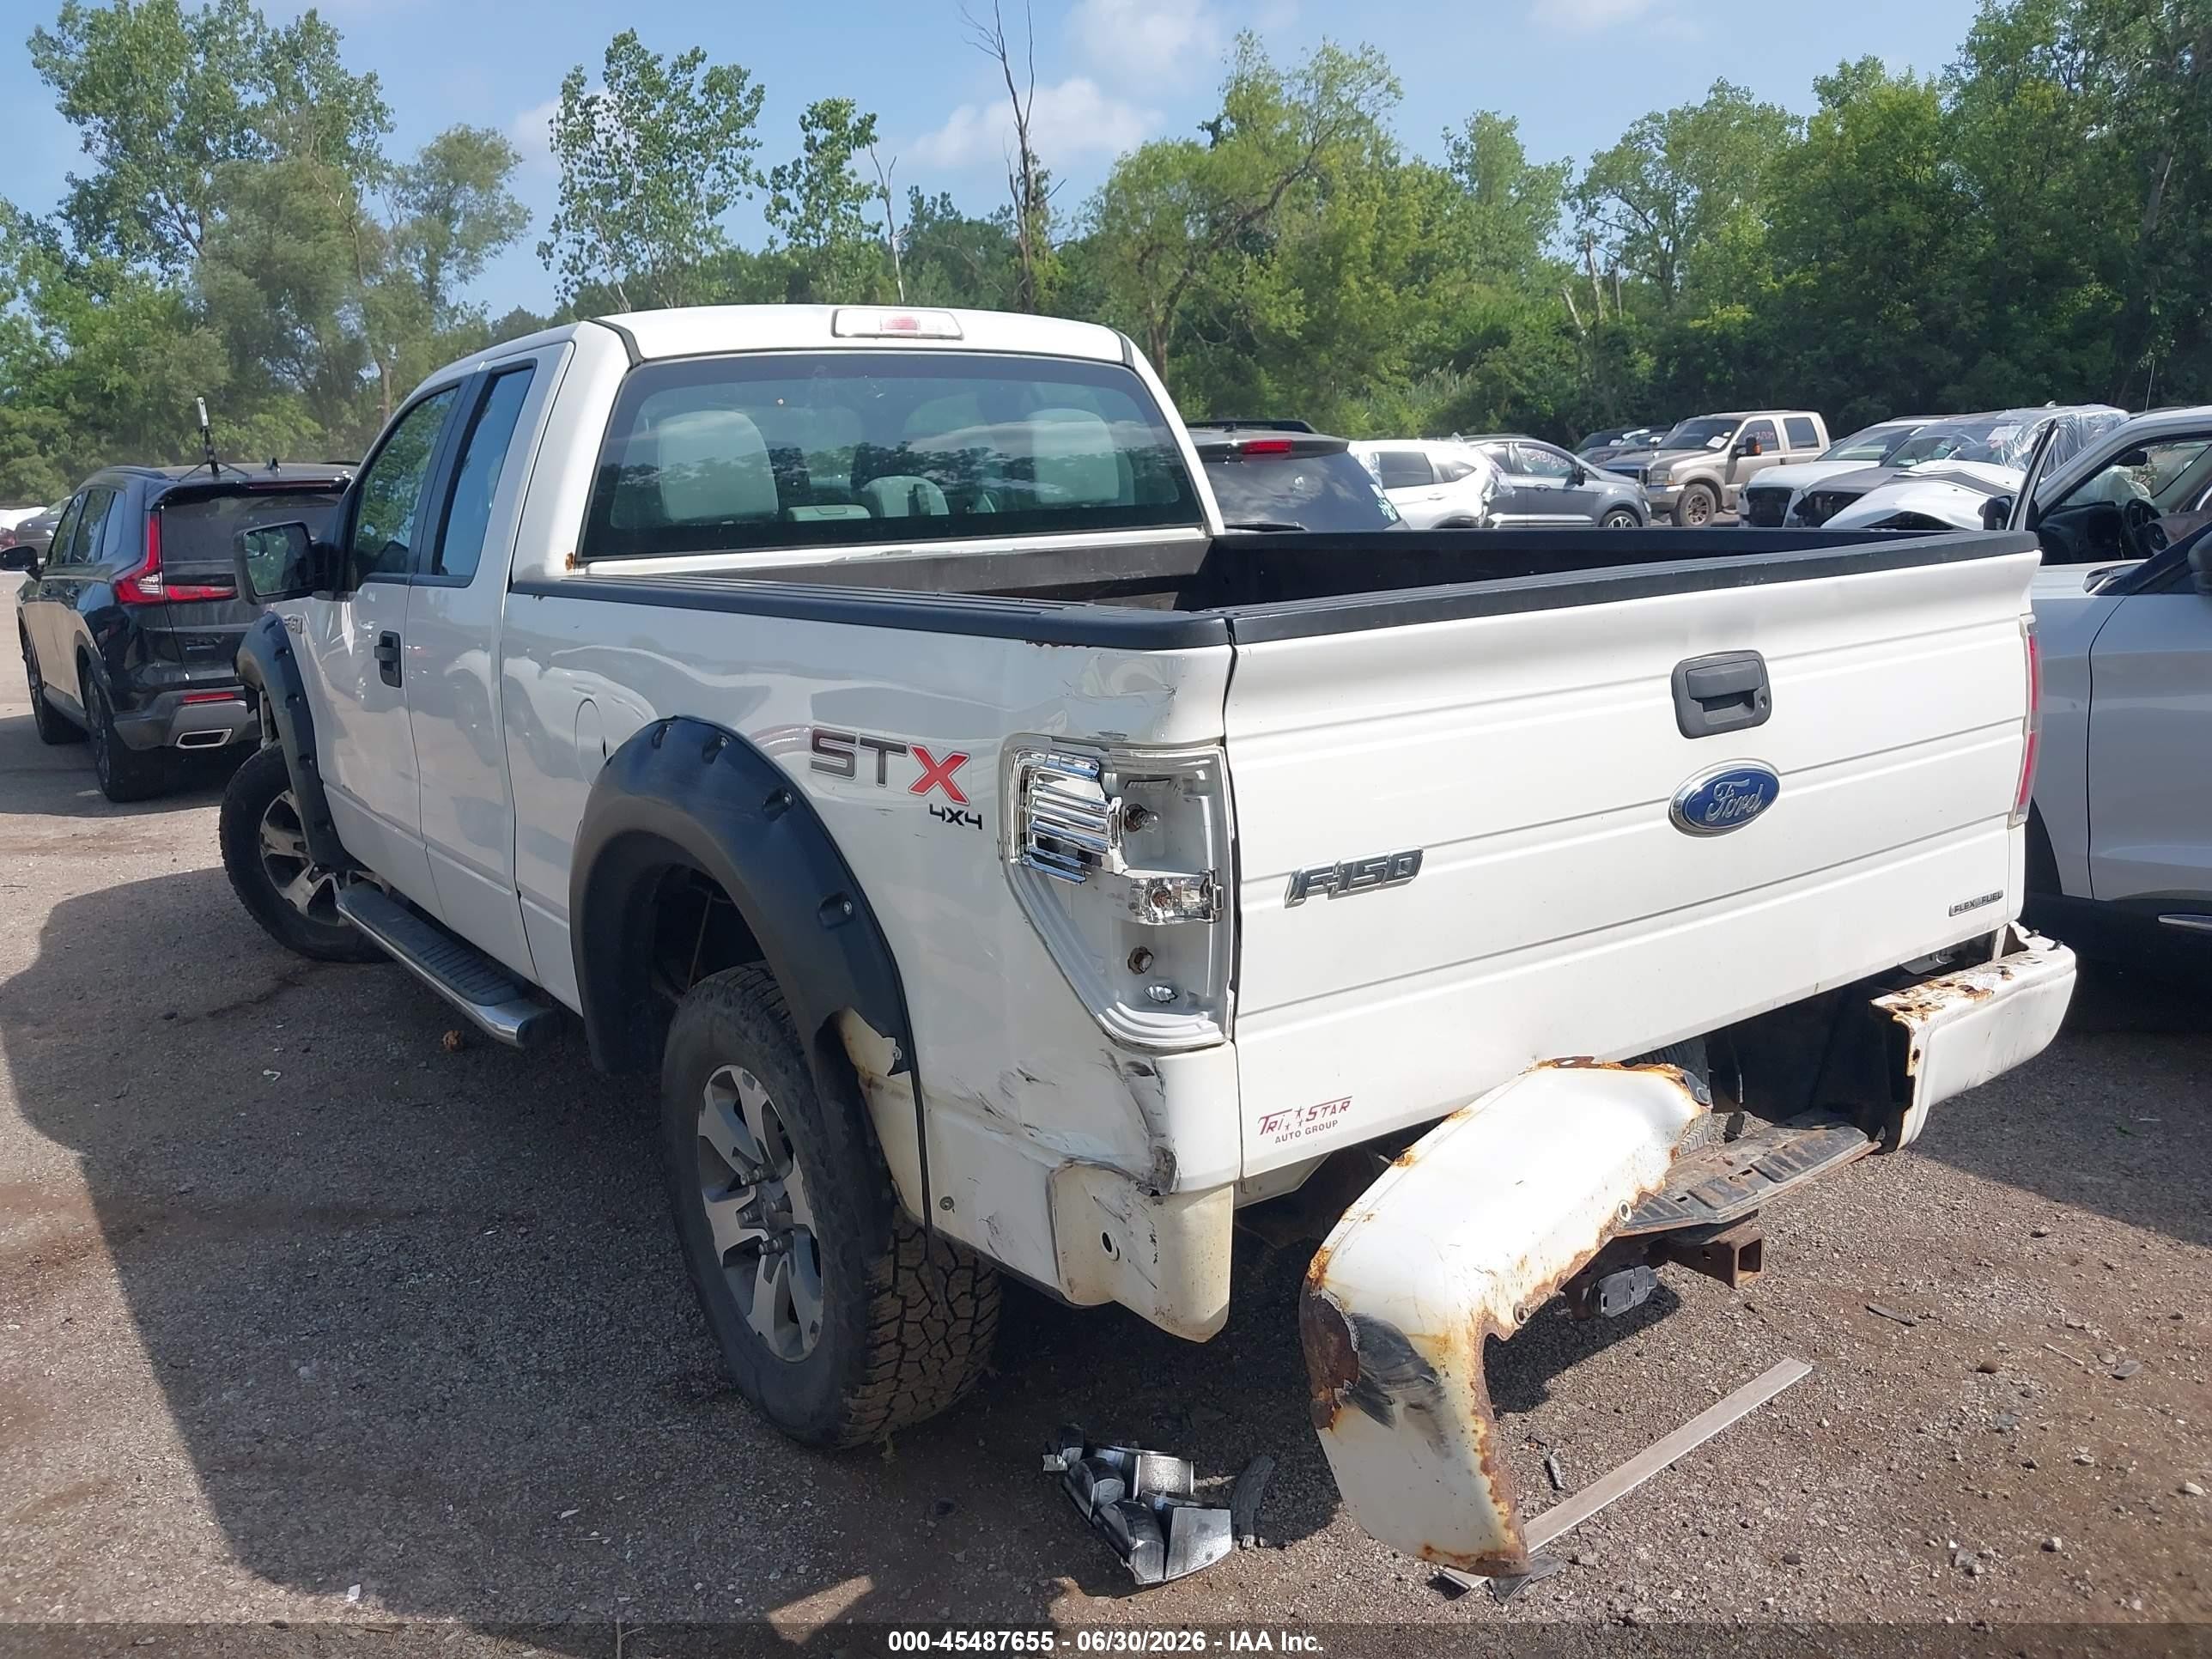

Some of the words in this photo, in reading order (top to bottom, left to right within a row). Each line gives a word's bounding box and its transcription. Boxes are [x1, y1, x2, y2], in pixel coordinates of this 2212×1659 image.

[810, 726, 970, 806] STX
[1705, 777, 1765, 822] Ford
[1285, 845, 1424, 909] F-150
[1953, 900, 1976, 914] FLEX
[1980, 891, 2004, 905] FUEL
[1274, 1130, 1302, 1145] AUTO
[1304, 1119, 1339, 1135] GROUP
